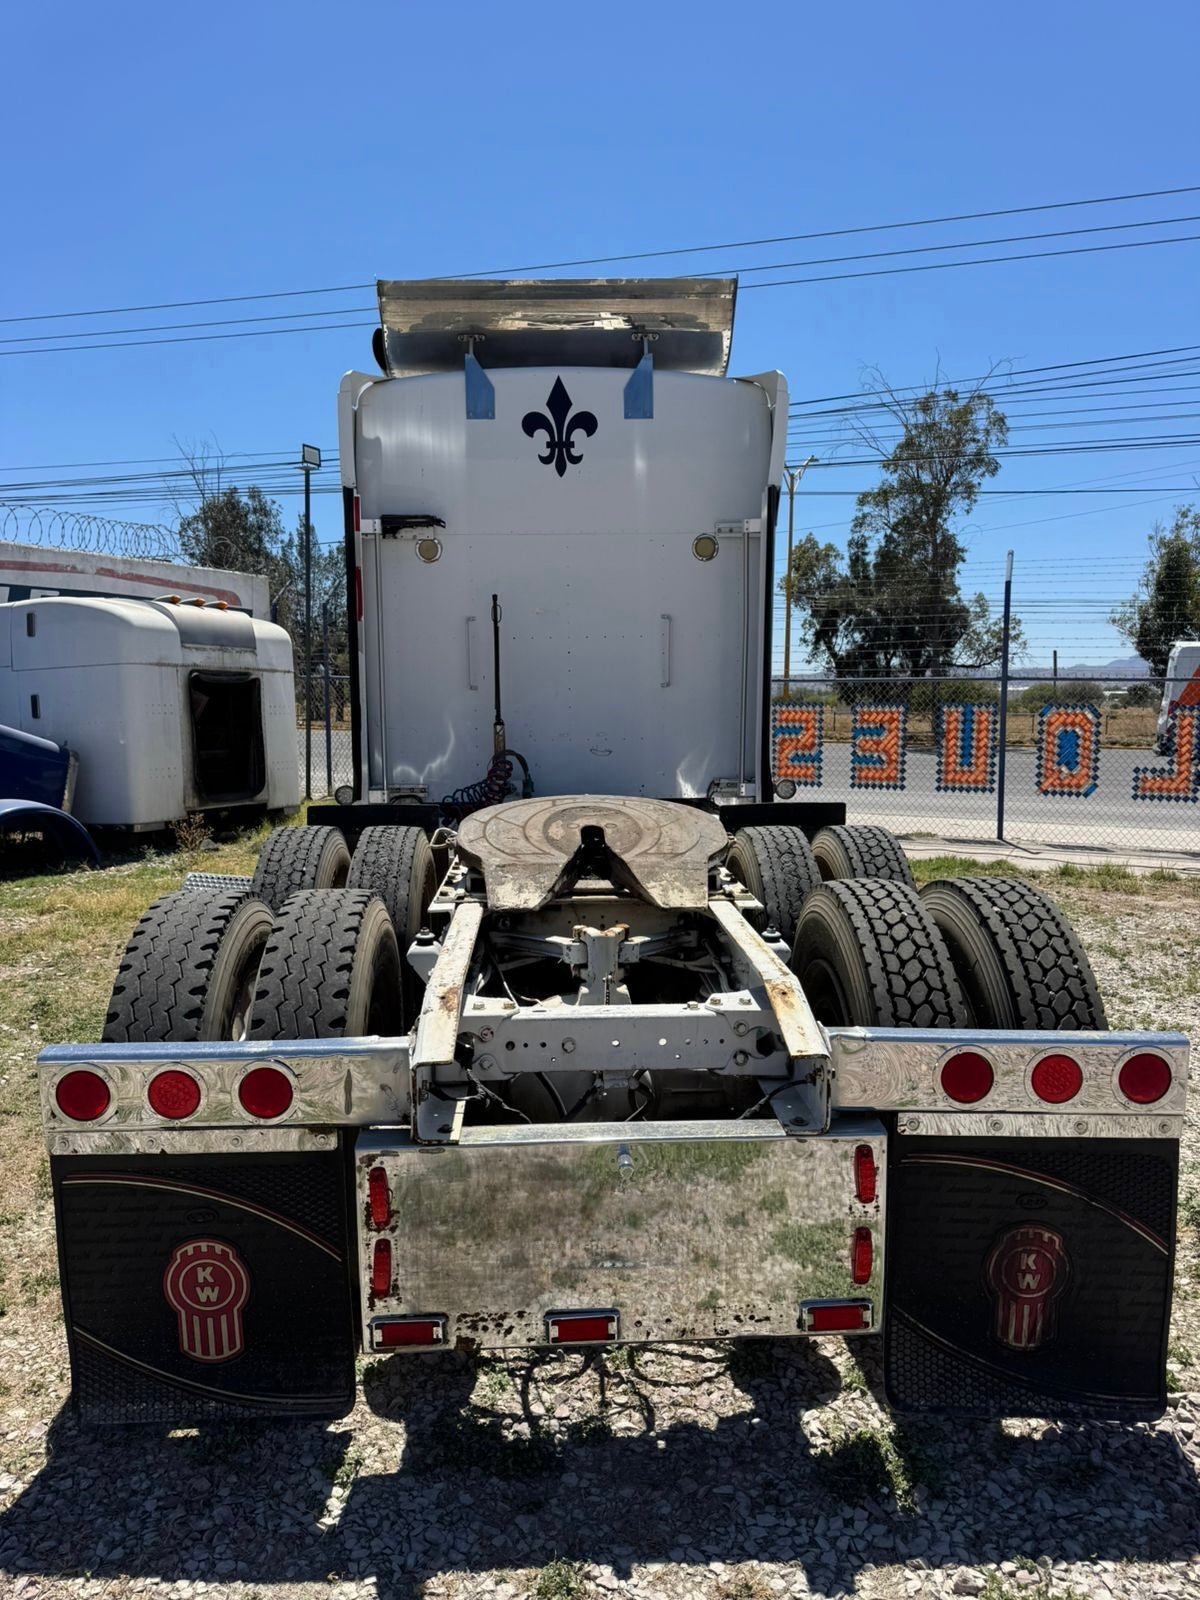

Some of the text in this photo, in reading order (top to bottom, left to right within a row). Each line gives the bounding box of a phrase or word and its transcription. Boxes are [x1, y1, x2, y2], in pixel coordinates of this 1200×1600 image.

[1020, 1253, 1037, 1270] K
[196, 1266, 214, 1283] K
[1016, 1273, 1041, 1290] W
[195, 1286, 219, 1302] W
